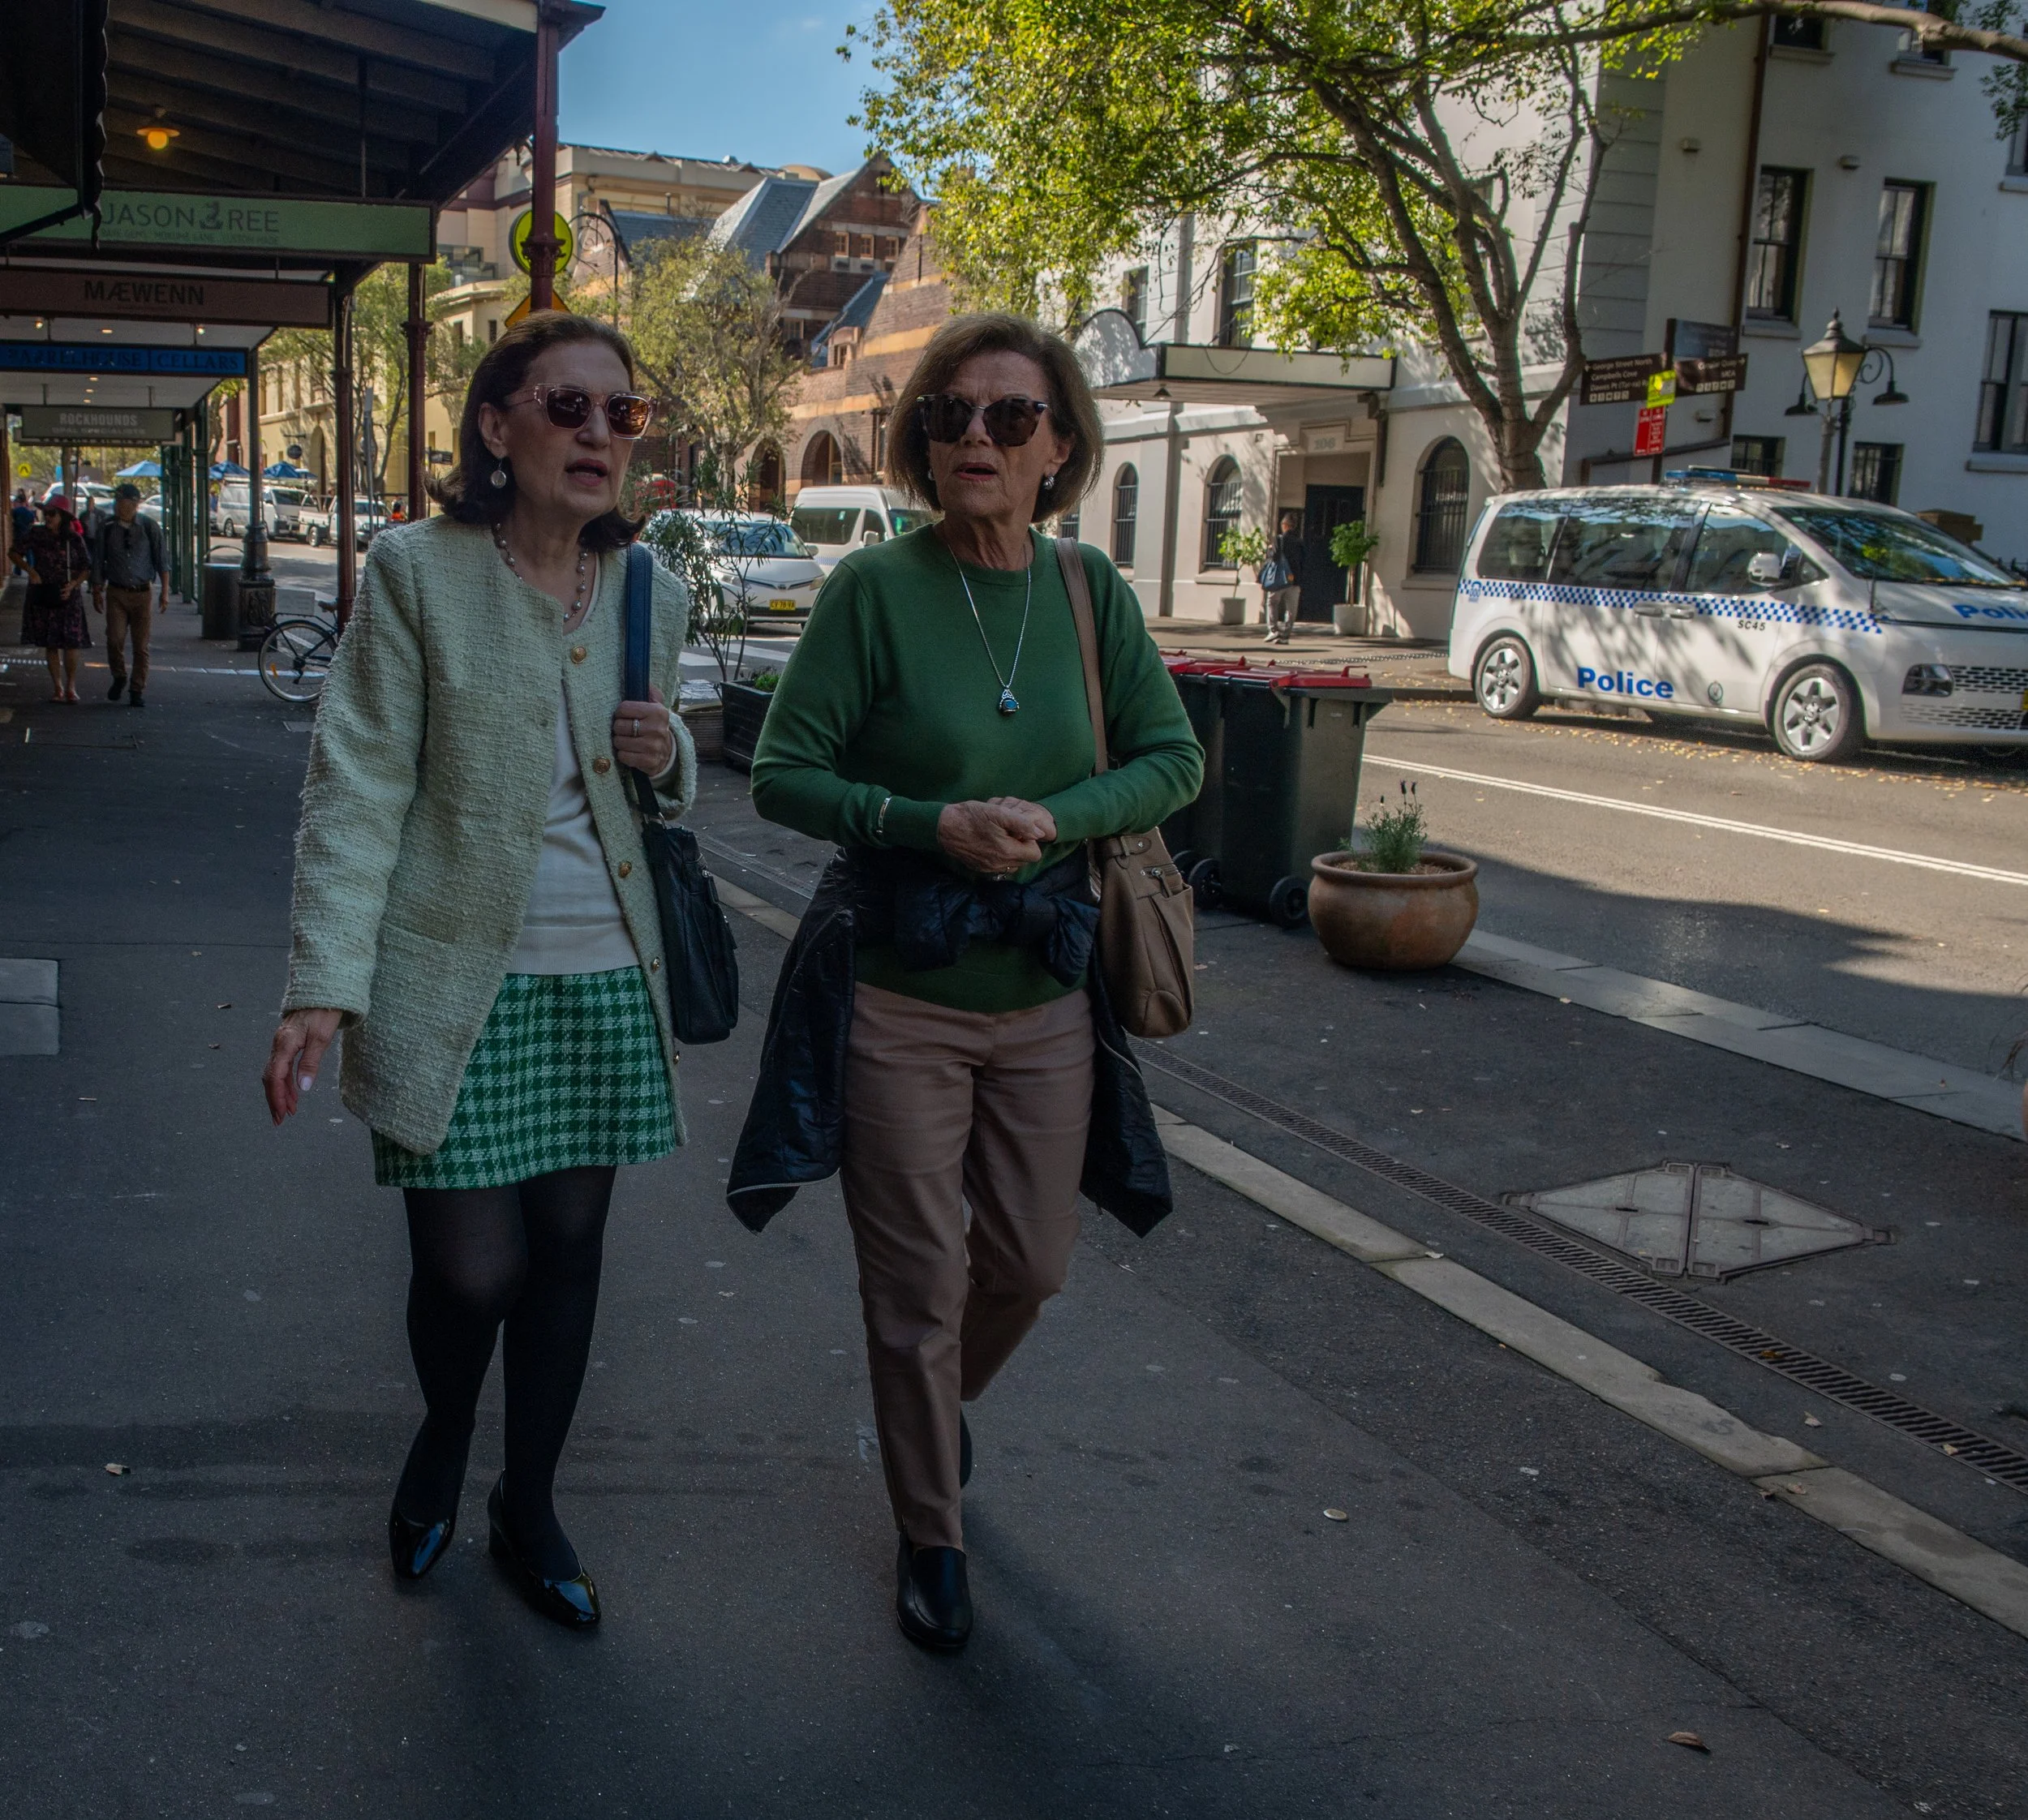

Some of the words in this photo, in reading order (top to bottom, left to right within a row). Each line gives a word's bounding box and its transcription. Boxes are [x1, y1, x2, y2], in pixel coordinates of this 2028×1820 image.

[101, 203, 195, 227] JASON
[228, 208, 280, 233] REE
[84, 280, 204, 306] MÆWENN
[157, 352, 238, 371] CELLARS
[1592, 363, 1614, 371] George
[1615, 360, 1634, 368] Street
[1634, 358, 1653, 367] North
[58, 412, 138, 427] ROCKHOUNDS
[1952, 604, 2028, 620] Poli
[1738, 619, 1766, 631] SC45
[1577, 667, 1674, 699] Police
